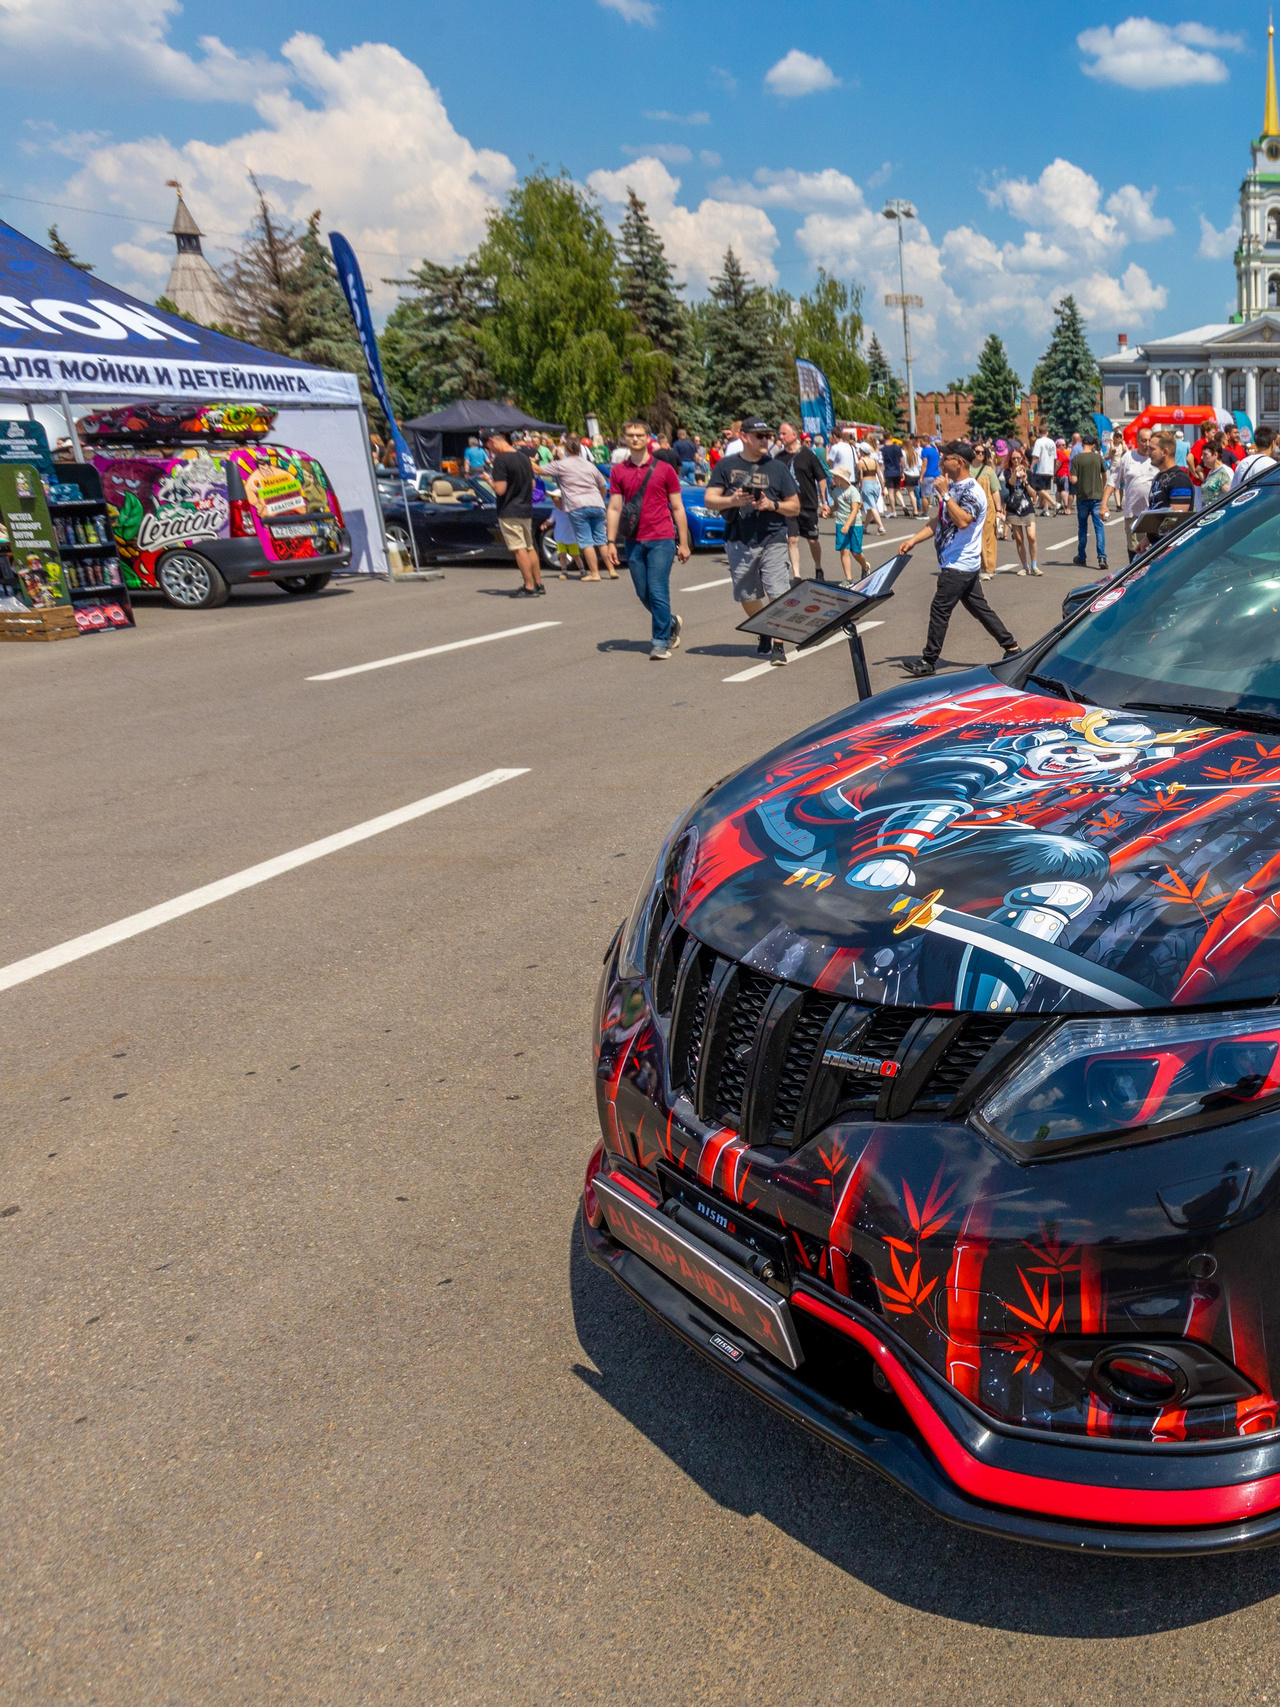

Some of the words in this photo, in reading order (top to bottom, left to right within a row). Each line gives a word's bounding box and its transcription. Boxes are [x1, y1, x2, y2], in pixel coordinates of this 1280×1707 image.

[0, 295, 201, 344] TON
[0, 356, 52, 381] ДЛЯ
[58, 357, 151, 384] МОЙКИ
[153, 365, 173, 386] И
[177, 366, 311, 394] ДЕТЕЙЛИНГА
[139, 511, 220, 547] Leraton
[821, 1049, 900, 1078] nismo
[697, 1200, 737, 1234] nismo
[713, 1335, 740, 1358] nismo
